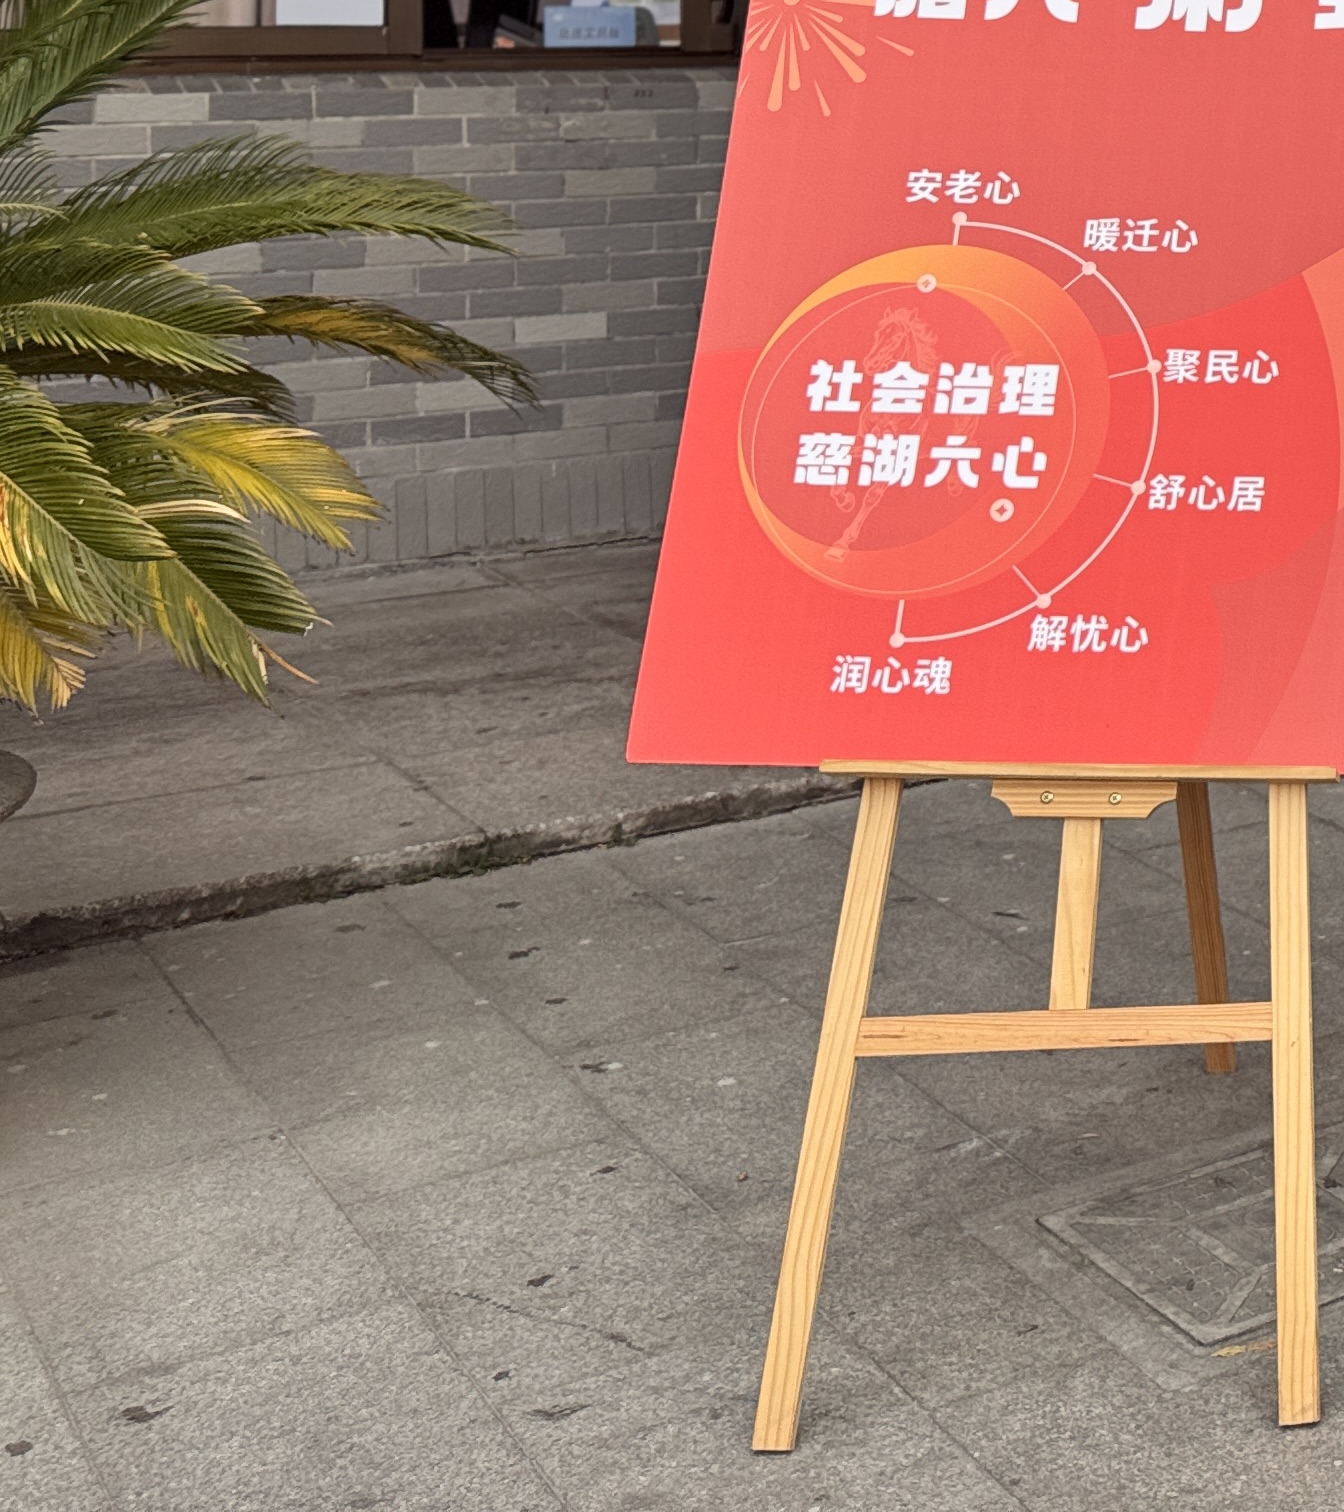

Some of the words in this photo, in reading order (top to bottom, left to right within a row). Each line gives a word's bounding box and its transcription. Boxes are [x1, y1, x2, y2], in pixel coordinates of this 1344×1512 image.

[906, 168, 1021, 205] 安老心
[1082, 217, 1199, 254] 暖迁心
[1162, 348, 1281, 385] 聚民心
[804, 359, 1060, 417] 社会治理
[792, 432, 1048, 490] 慈湖六心
[1146, 472, 1267, 513] 舒心居
[1026, 614, 1150, 654] 解忧心
[829, 654, 954, 696] 润心魂
